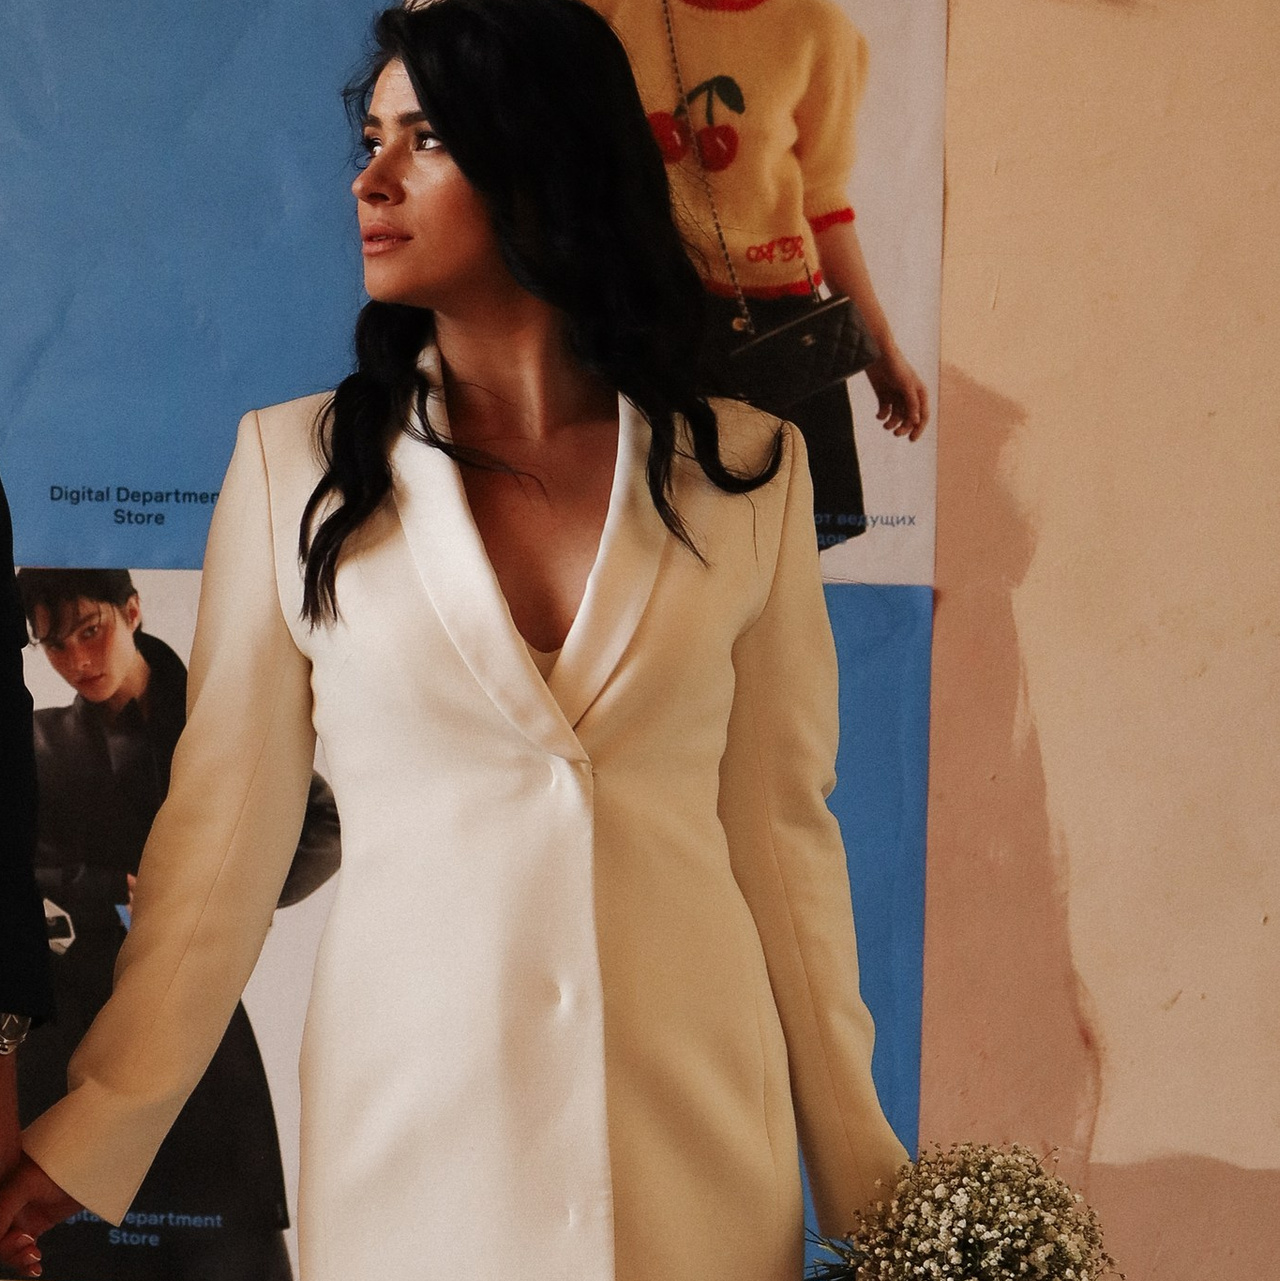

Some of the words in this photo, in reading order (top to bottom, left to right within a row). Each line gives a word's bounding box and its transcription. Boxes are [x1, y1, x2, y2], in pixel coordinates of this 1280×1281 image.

[50, 486, 110, 505] Digital
[116, 487, 220, 506] Departmen
[113, 508, 165, 526] Store
[838, 514, 916, 528] ведущих
[125, 1211, 222, 1228] epartment
[109, 1228, 160, 1246] Store
